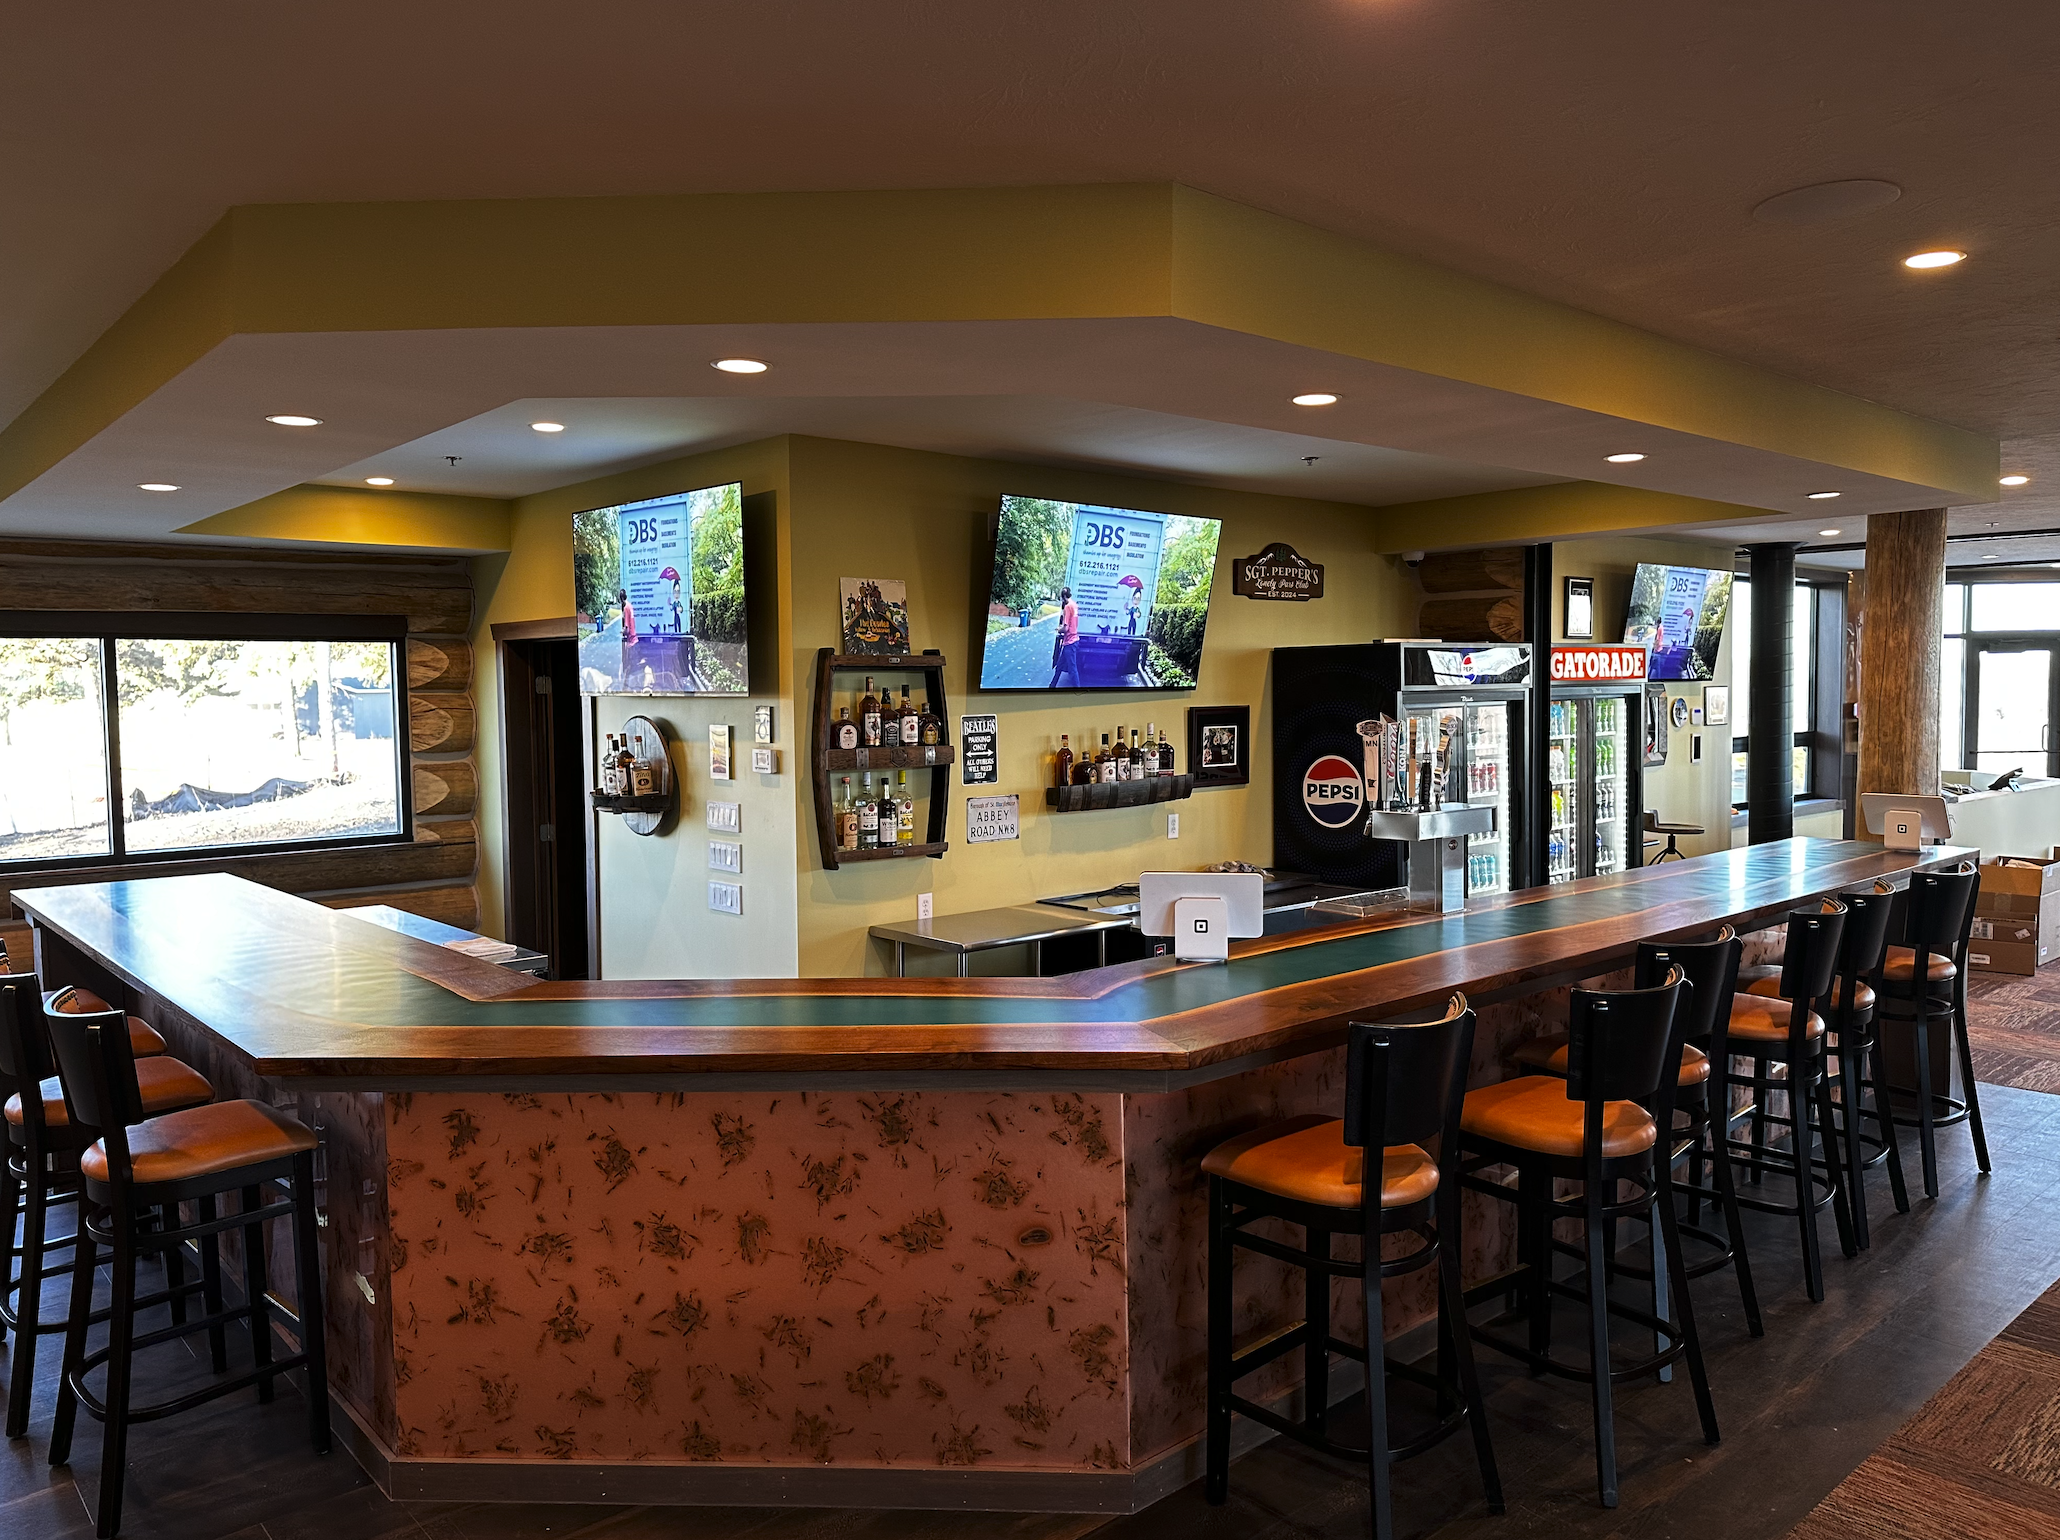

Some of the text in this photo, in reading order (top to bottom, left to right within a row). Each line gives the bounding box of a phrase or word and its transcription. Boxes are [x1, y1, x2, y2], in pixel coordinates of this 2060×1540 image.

[628, 517, 658, 546] DBS
[1085, 522, 1125, 549] DBS
[1079, 568, 1118, 577] dbsrepair.com
[1080, 561, 1119, 571] 612.216.1121
[1245, 565, 1319, 584] SGT. PEPPER'S
[1670, 577, 1689, 593] DBS
[1551, 652, 1643, 679] GATORADE
[963, 719, 996, 735] BEATLES
[972, 743, 987, 751] ONLY
[1398, 743, 1407, 772] KONA
[1307, 783, 1359, 800] PEPSI
[976, 809, 1010, 822] ABBEY
[970, 823, 1015, 838] ROAD NW8
